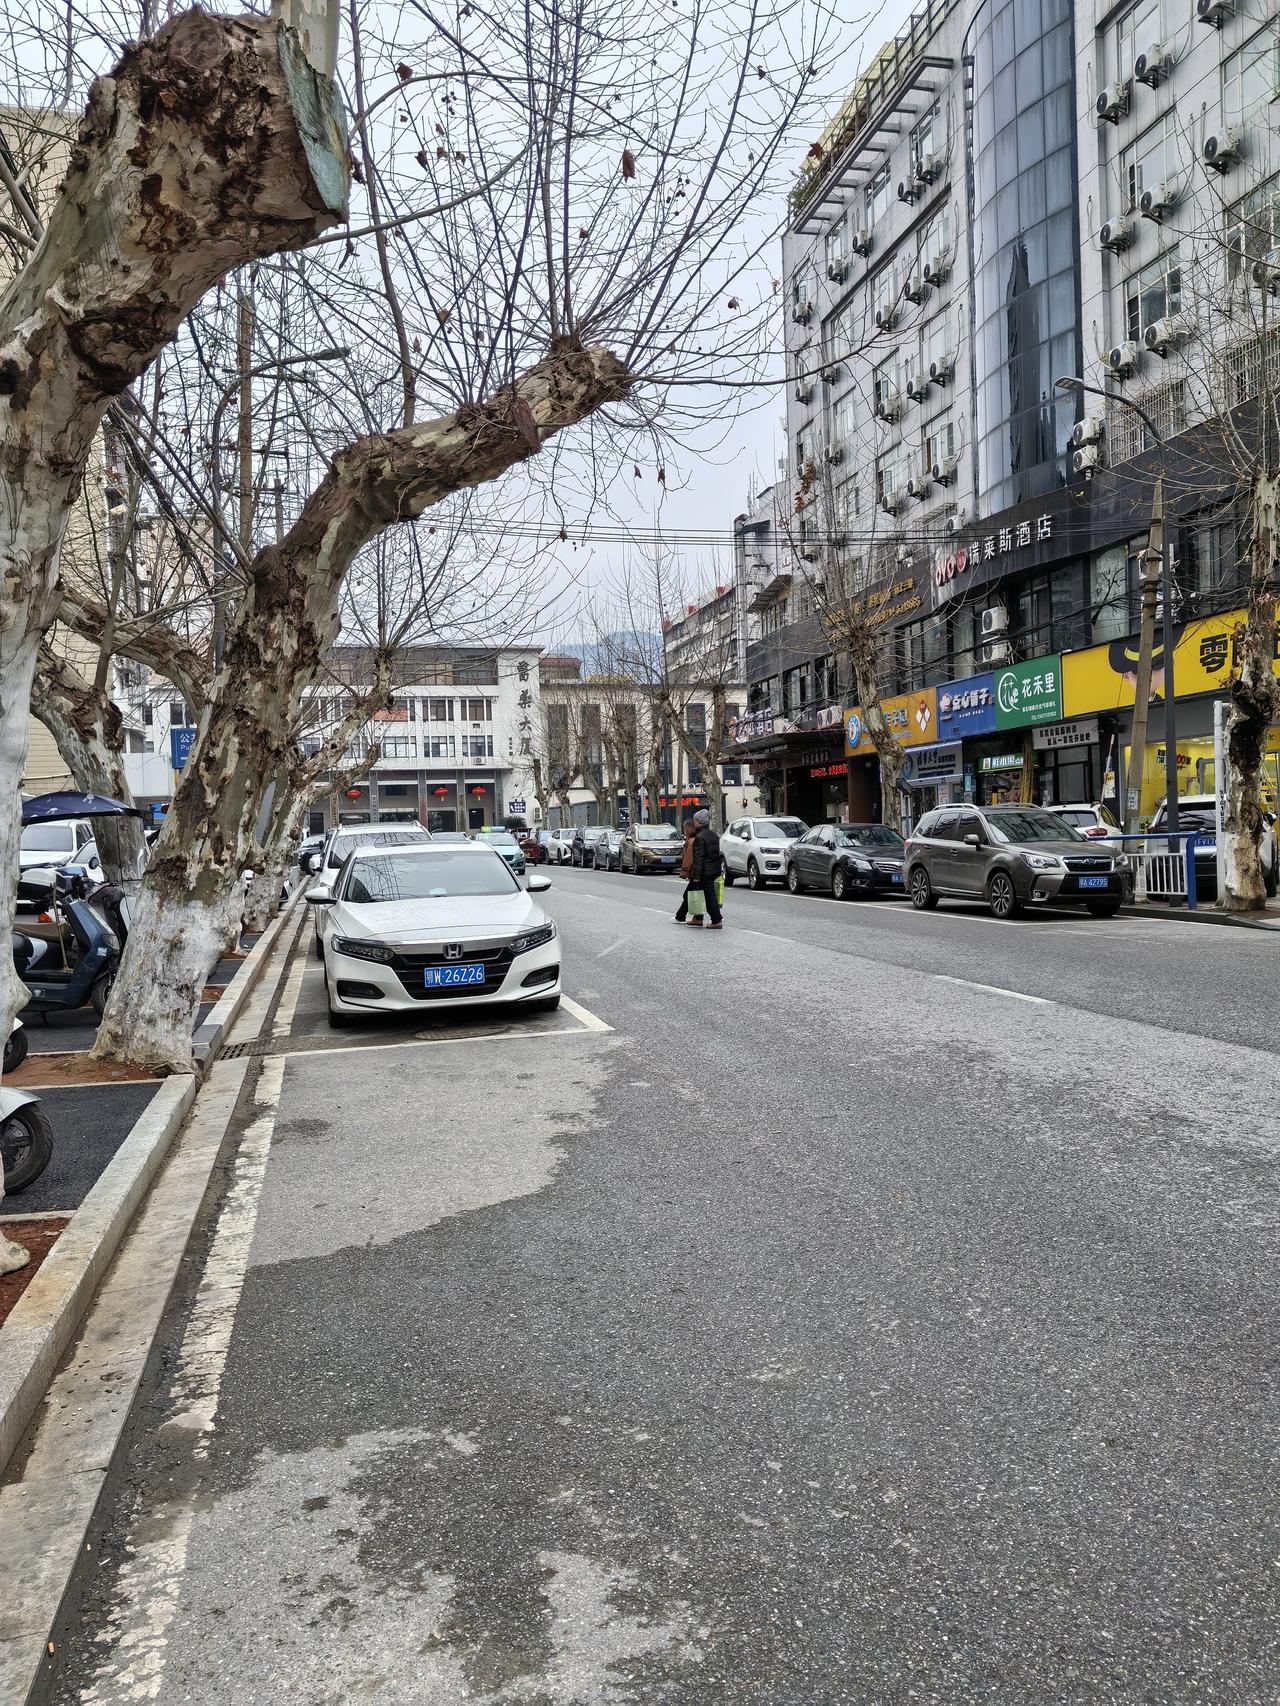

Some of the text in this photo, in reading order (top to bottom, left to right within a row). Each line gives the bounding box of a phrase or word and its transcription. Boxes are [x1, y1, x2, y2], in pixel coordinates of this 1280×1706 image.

[969, 513, 1053, 566] 瑞莱斯酒店
[1021, 671, 1056, 699] 花禾里
